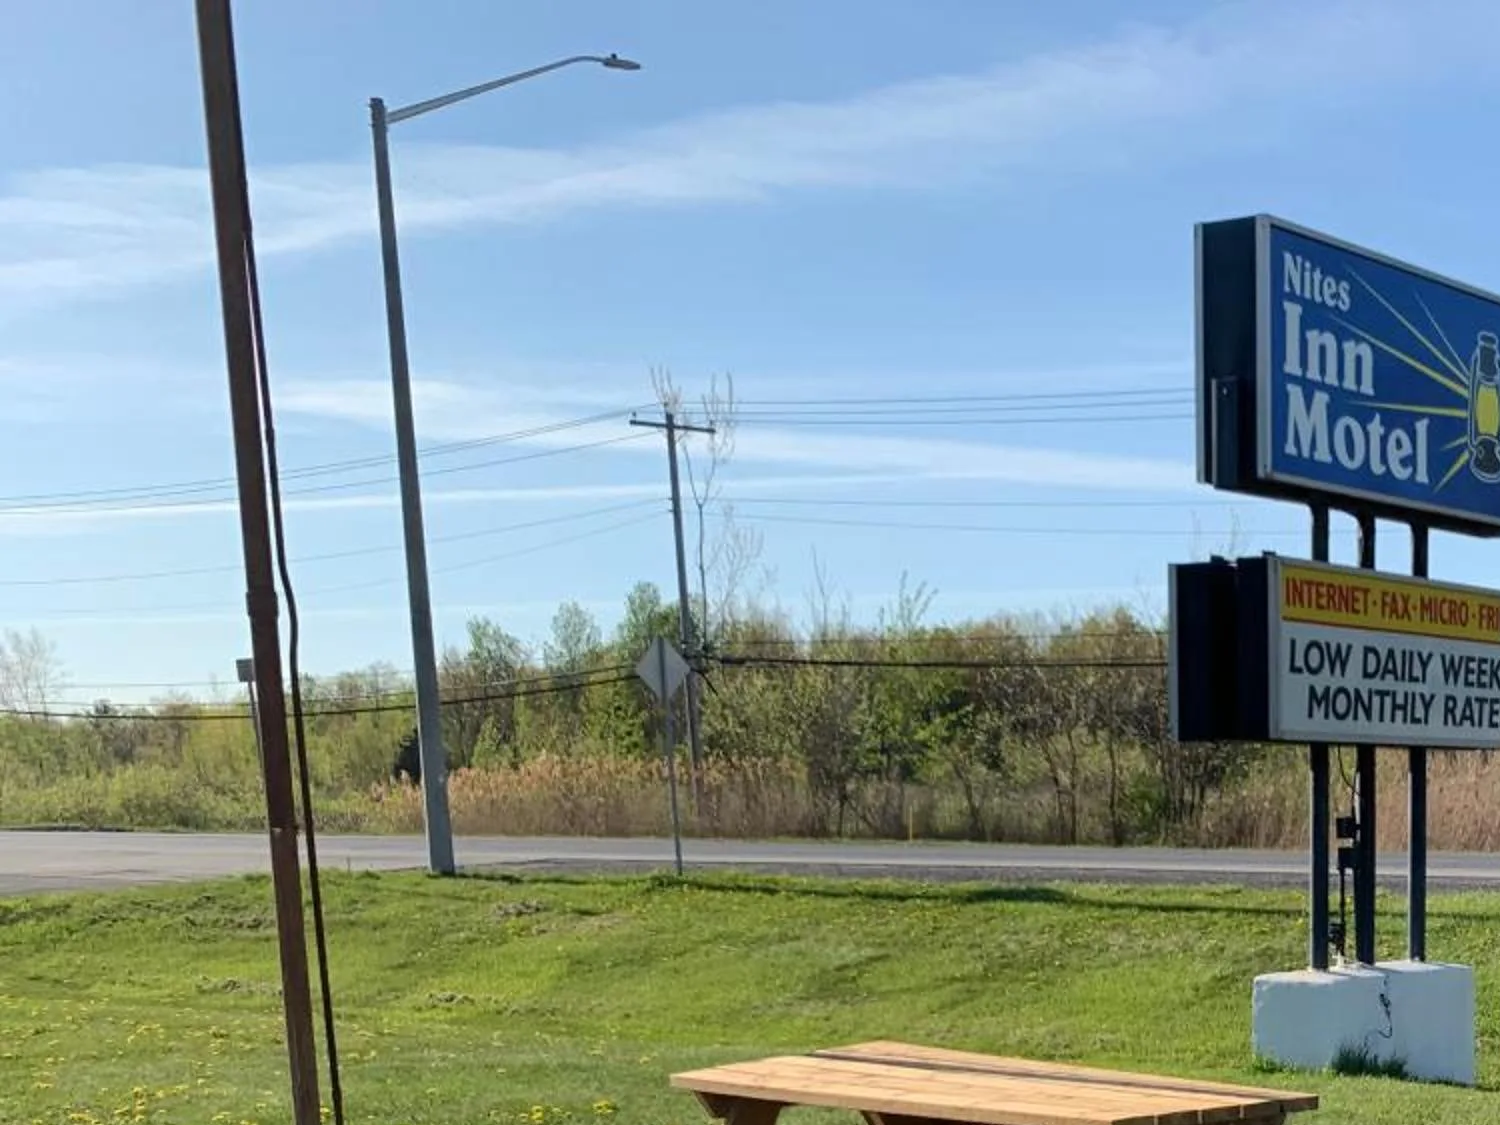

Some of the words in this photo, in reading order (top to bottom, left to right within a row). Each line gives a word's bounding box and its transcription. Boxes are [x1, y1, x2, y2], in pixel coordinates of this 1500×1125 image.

[1282, 252, 1351, 313] Nites
[1282, 302, 1375, 397] Inn
[1284, 384, 1430, 485] Motel
[1288, 638, 1352, 678] LOW
[1362, 646, 1434, 684] DAILY
[1307, 685, 1437, 726] MONTHLY
